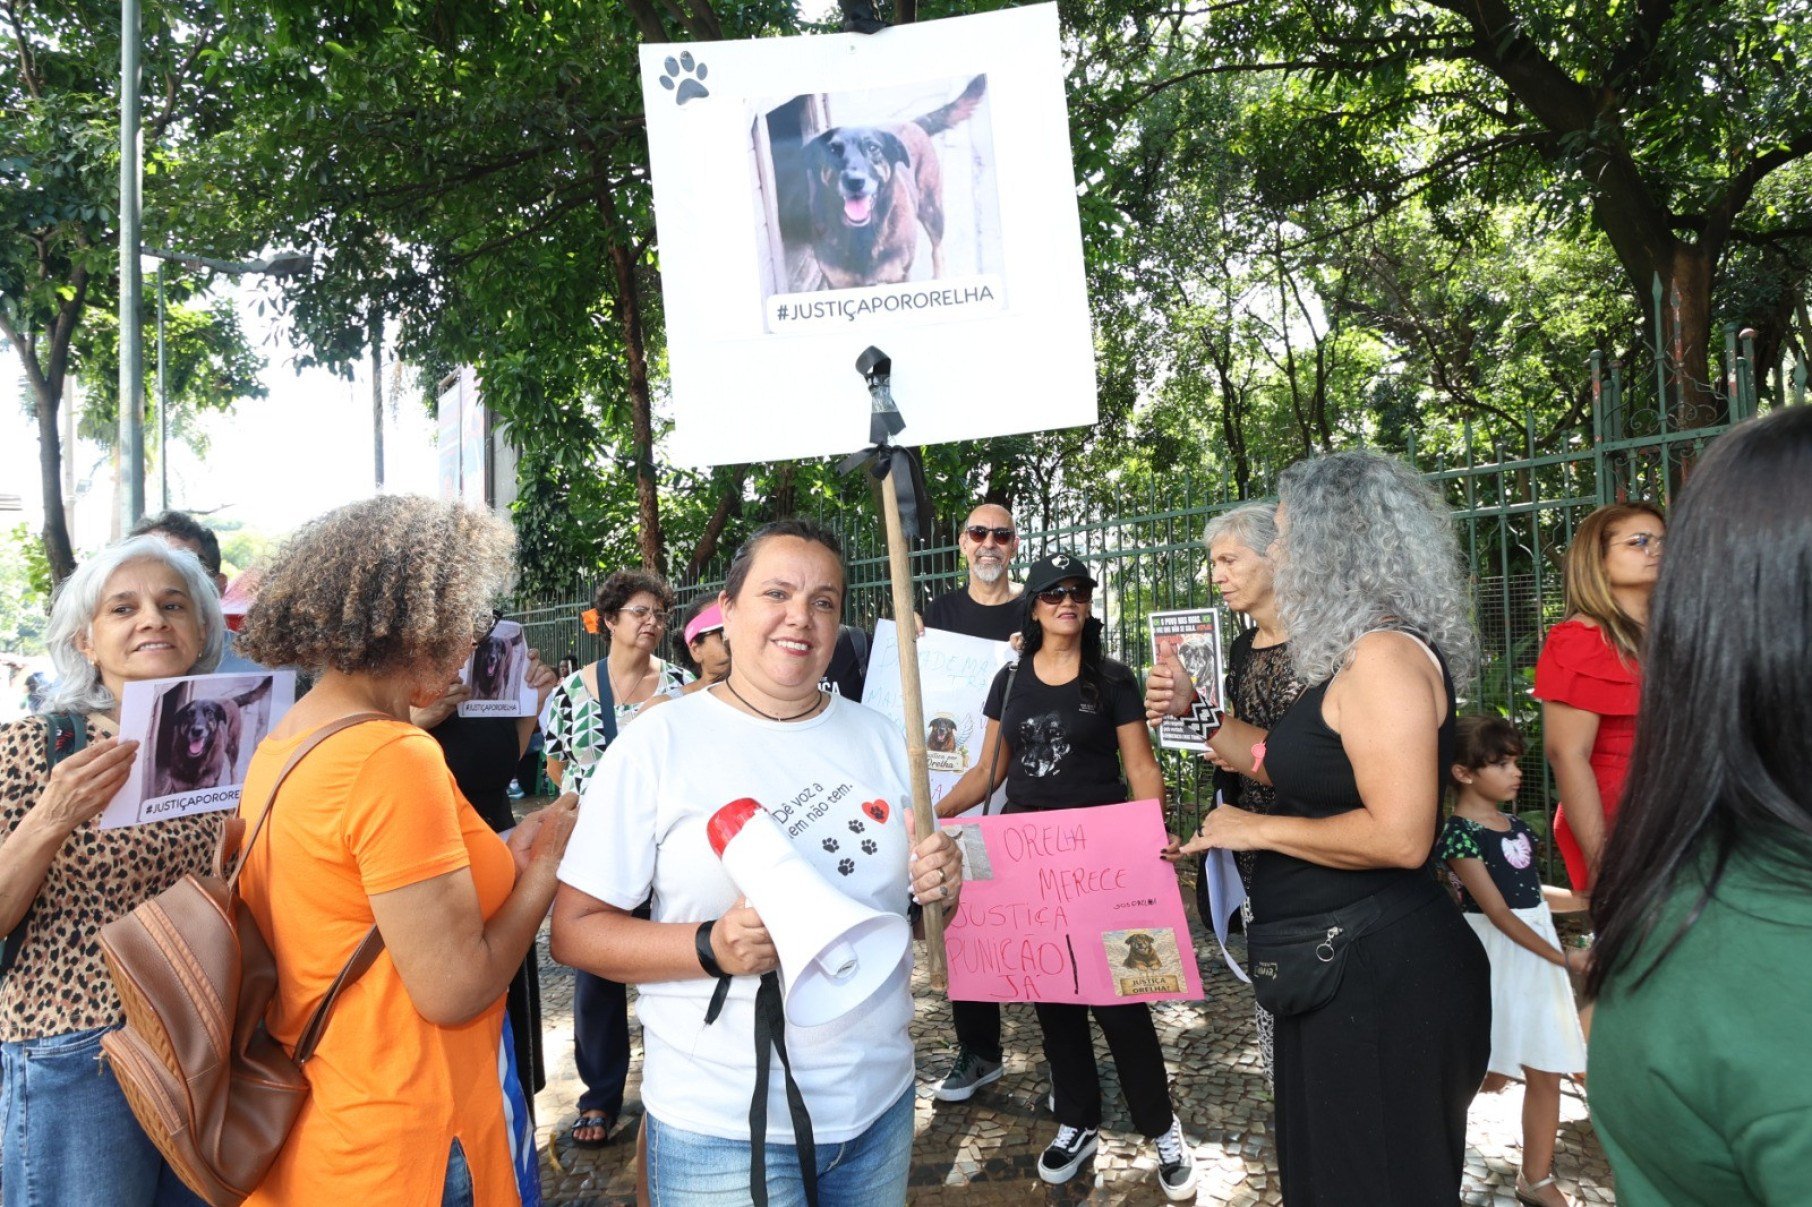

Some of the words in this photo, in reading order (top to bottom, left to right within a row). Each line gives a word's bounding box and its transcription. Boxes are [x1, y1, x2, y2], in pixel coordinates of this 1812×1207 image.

[777, 285, 994, 321] #JUSTIÇAPORORELHA
[145, 789, 240, 814] #JUSTIÇAPORORE
[772, 803, 795, 824] Dê
[790, 787, 817, 807] voz
[812, 782, 824, 792] a
[787, 819, 810, 839] em
[806, 802, 829, 822] não
[827, 783, 853, 804] tem.
[1003, 823, 1088, 862] ORELHA
[1038, 867, 1128, 903] MERECE
